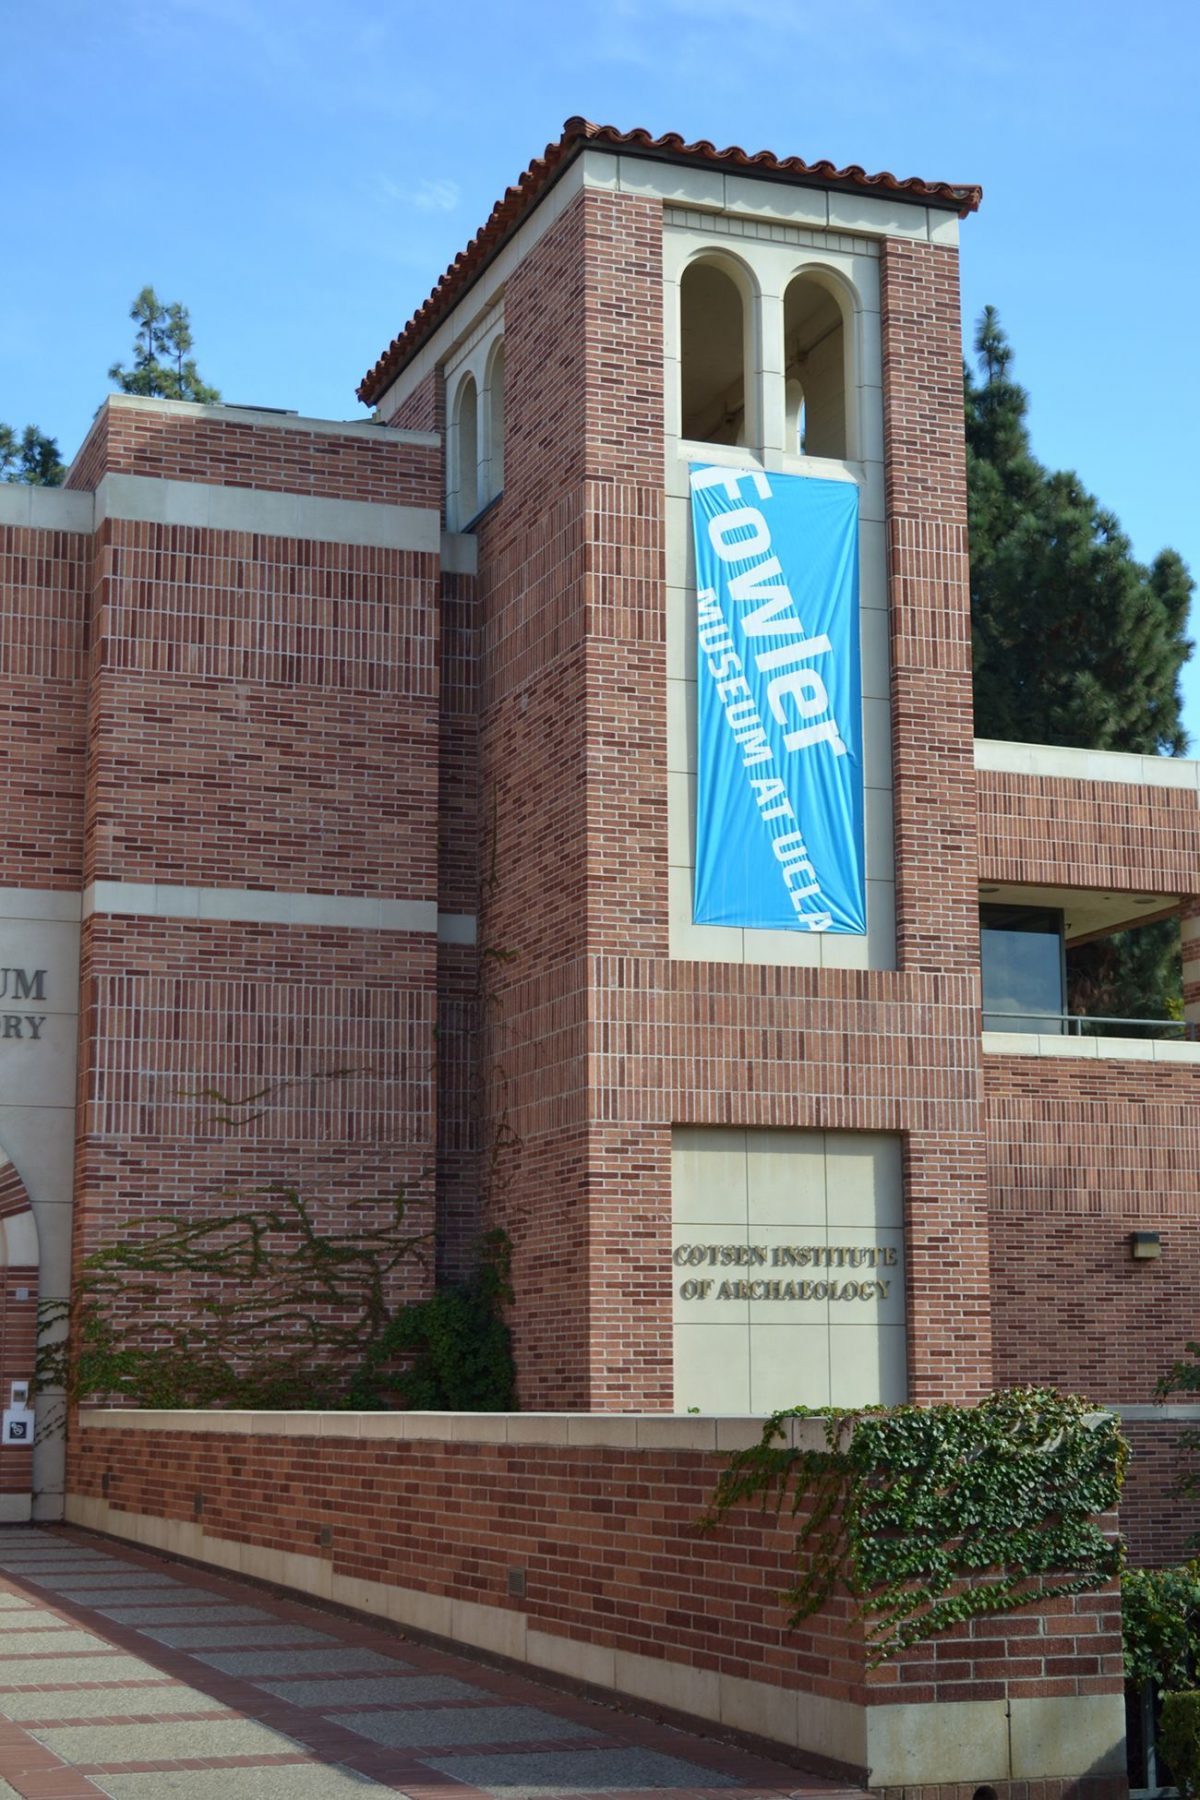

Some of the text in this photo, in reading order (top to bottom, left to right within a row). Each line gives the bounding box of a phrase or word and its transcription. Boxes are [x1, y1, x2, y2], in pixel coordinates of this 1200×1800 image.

[697, 588, 834, 932] MUSEUM AT UCLA
[0, 1014, 47, 1040] RY
[673, 1243, 898, 1269] COTSEN INSTITUTE
[679, 1278, 891, 1302] OF ARCHAEOLOGY
